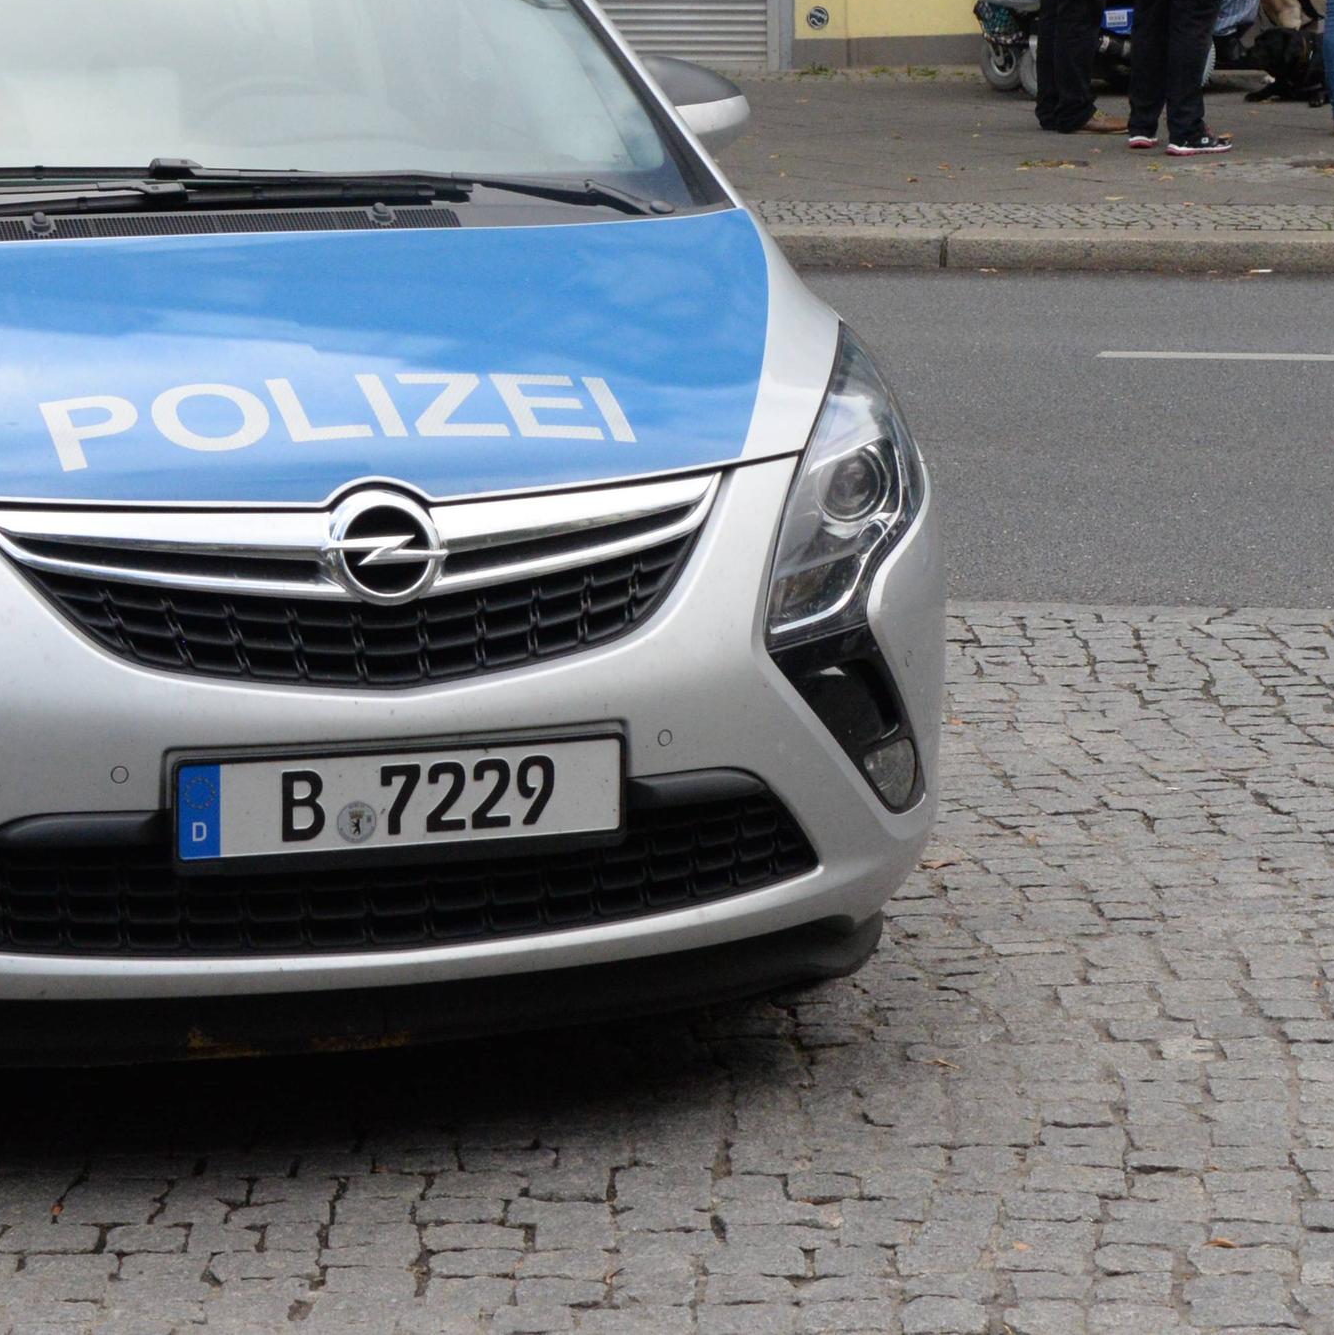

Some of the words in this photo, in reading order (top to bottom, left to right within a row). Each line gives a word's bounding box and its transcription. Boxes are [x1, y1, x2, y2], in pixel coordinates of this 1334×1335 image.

[39, 373, 638, 472] POLIZEI
[191, 821, 208, 843] D
[281, 769, 326, 843] B
[380, 754, 556, 836] 7229
